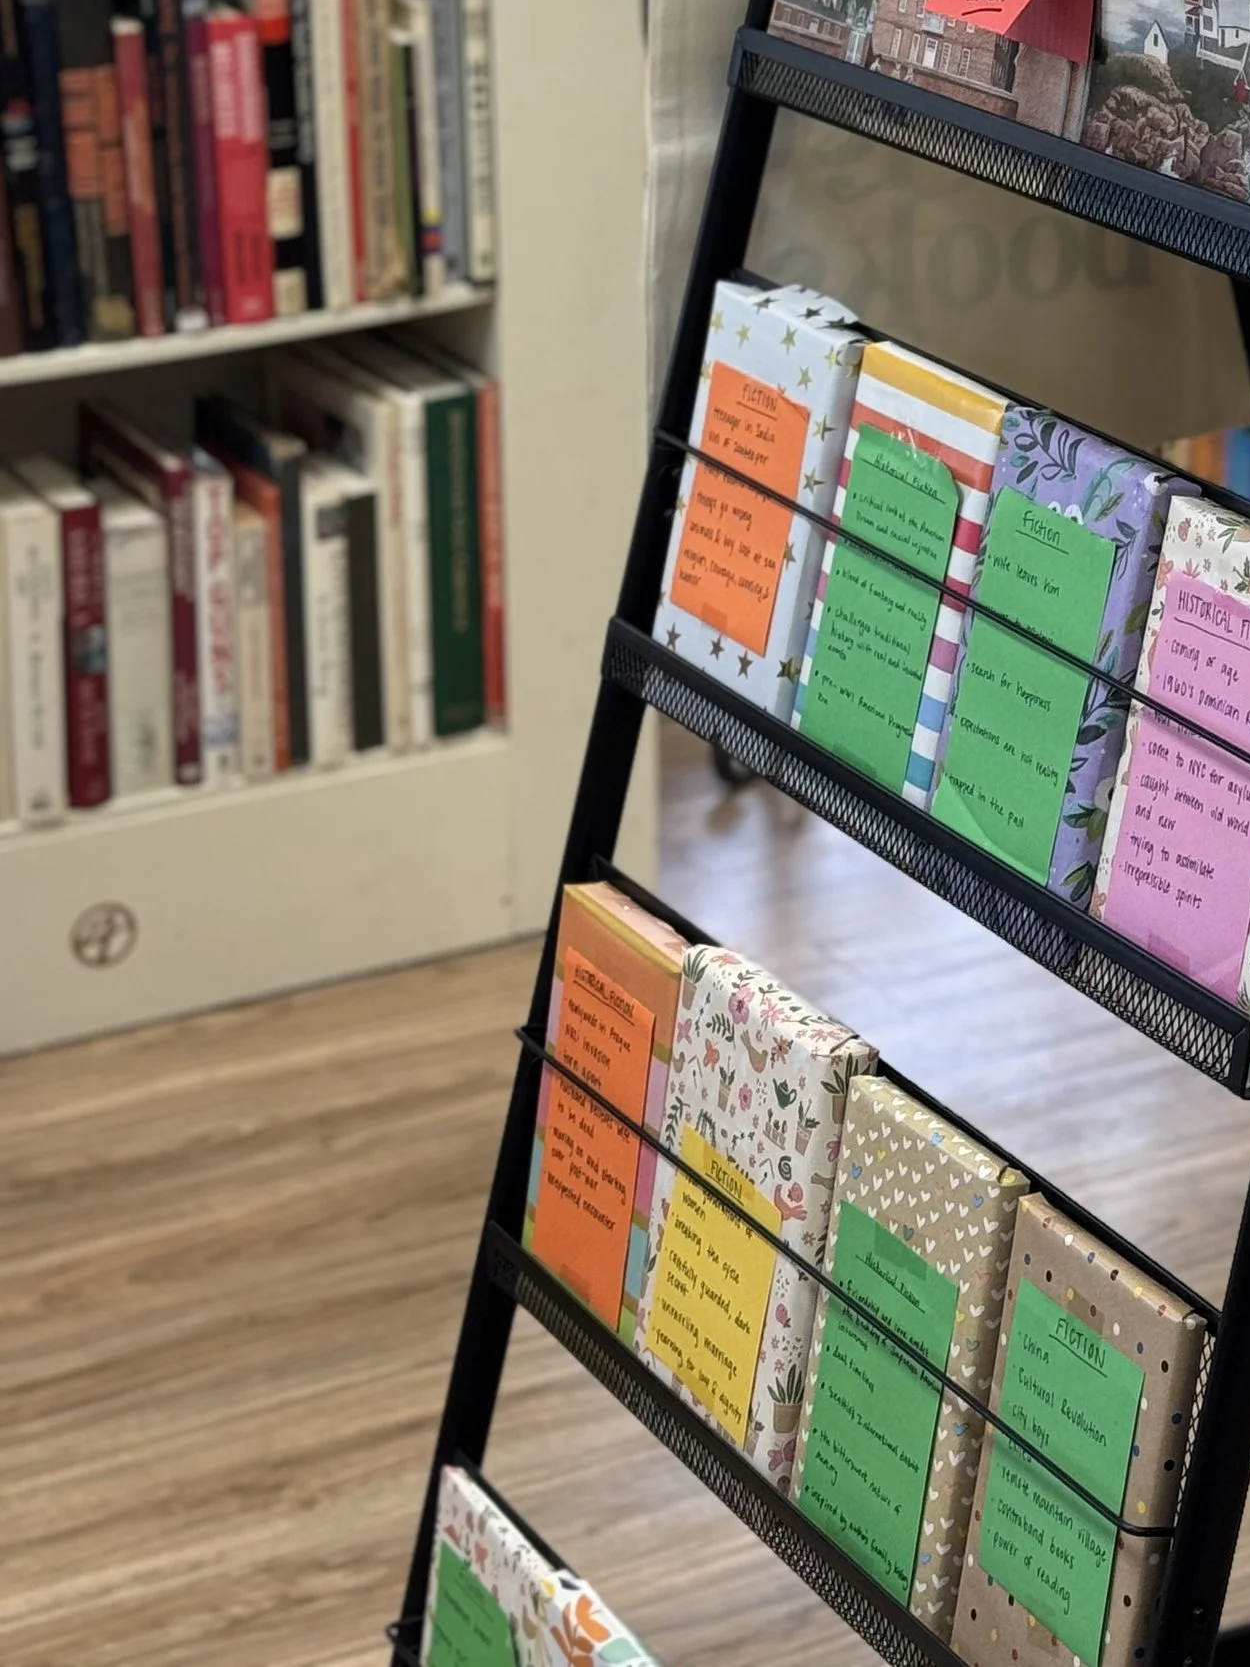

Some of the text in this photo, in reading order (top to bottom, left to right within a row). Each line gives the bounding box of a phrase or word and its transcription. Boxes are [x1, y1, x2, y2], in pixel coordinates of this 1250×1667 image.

[742, 383, 778, 412] FICTION
[1022, 510, 1061, 546] Fiction
[1016, 564, 1038, 588] leaves
[1043, 578, 1060, 597] him
[1178, 590, 1232, 633] HISTORICAL
[1171, 639, 1239, 685] coming of age
[970, 662, 1052, 713] search for happiness
[1163, 675, 1194, 698] 1960's
[1198, 689, 1239, 721] Dominican
[1003, 742, 1016, 756] are
[1020, 751, 1033, 765] not
[1035, 760, 1059, 788] reality
[1148, 741, 1169, 761] come
[1176, 752, 1184, 768] to
[1188, 759, 1207, 778] NYC
[1210, 770, 1224, 785] for
[949, 774, 975, 797] trapped
[978, 786, 986, 803] in
[989, 796, 1004, 815] the
[1140, 774, 1169, 801] caught
[1210, 806, 1224, 821] old
[1227, 815, 1250, 837] world
[1135, 804, 1176, 831] and new
[1130, 833, 1154, 866] trying
[1161, 847, 1170, 862] to
[1176, 889, 1203, 909] spirits
[710, 1159, 743, 1200] FICTION
[704, 1337, 737, 1381] marriage
[1023, 1334, 1050, 1365] China
[1055, 1317, 1106, 1370] FICTION
[1018, 1367, 1107, 1447] Cultural Revolution
[1032, 1417, 1050, 1449] boys
[997, 1499, 1075, 1570] contraband books
[1001, 1466, 1106, 1568] remote mountain village
[993, 1531, 1071, 1615] power of reading
